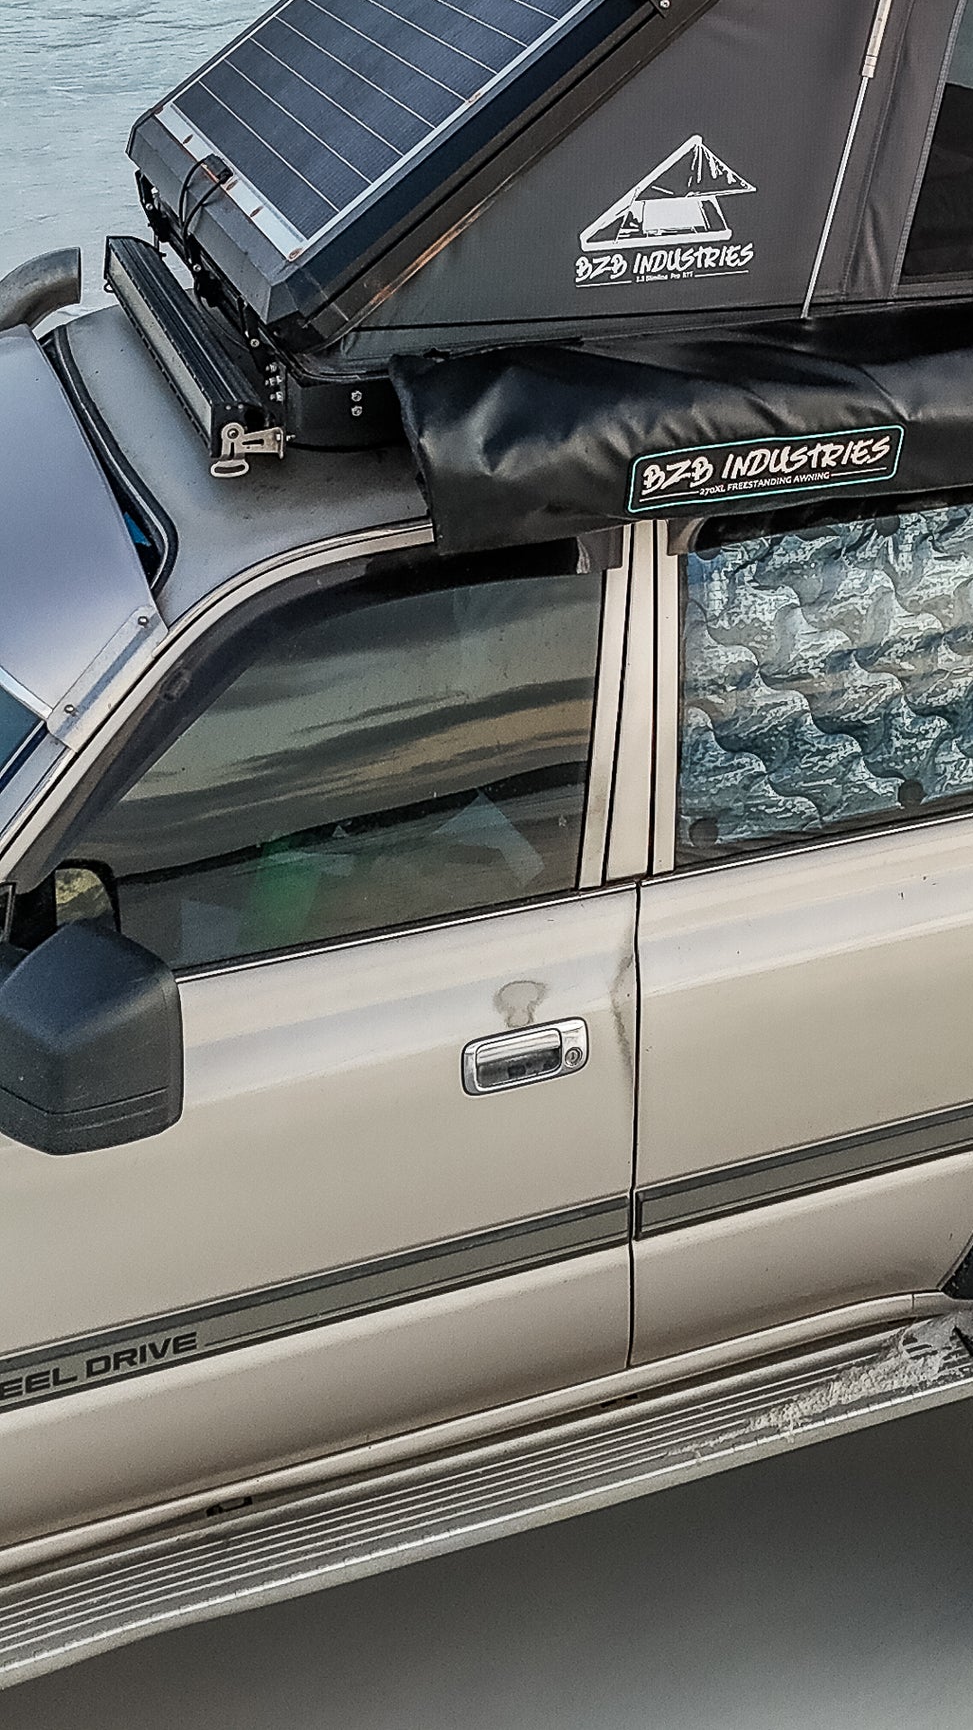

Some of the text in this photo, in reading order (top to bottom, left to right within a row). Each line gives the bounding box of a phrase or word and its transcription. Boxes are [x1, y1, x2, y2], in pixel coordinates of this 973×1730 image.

[575, 243, 754, 283] BZB INDUSTRIES
[641, 435, 891, 496] BZB INDUSTRIES
[699, 471, 830, 497] 270XL FREESTANDING AWNING
[85, 1331, 197, 1379] DRIVE
